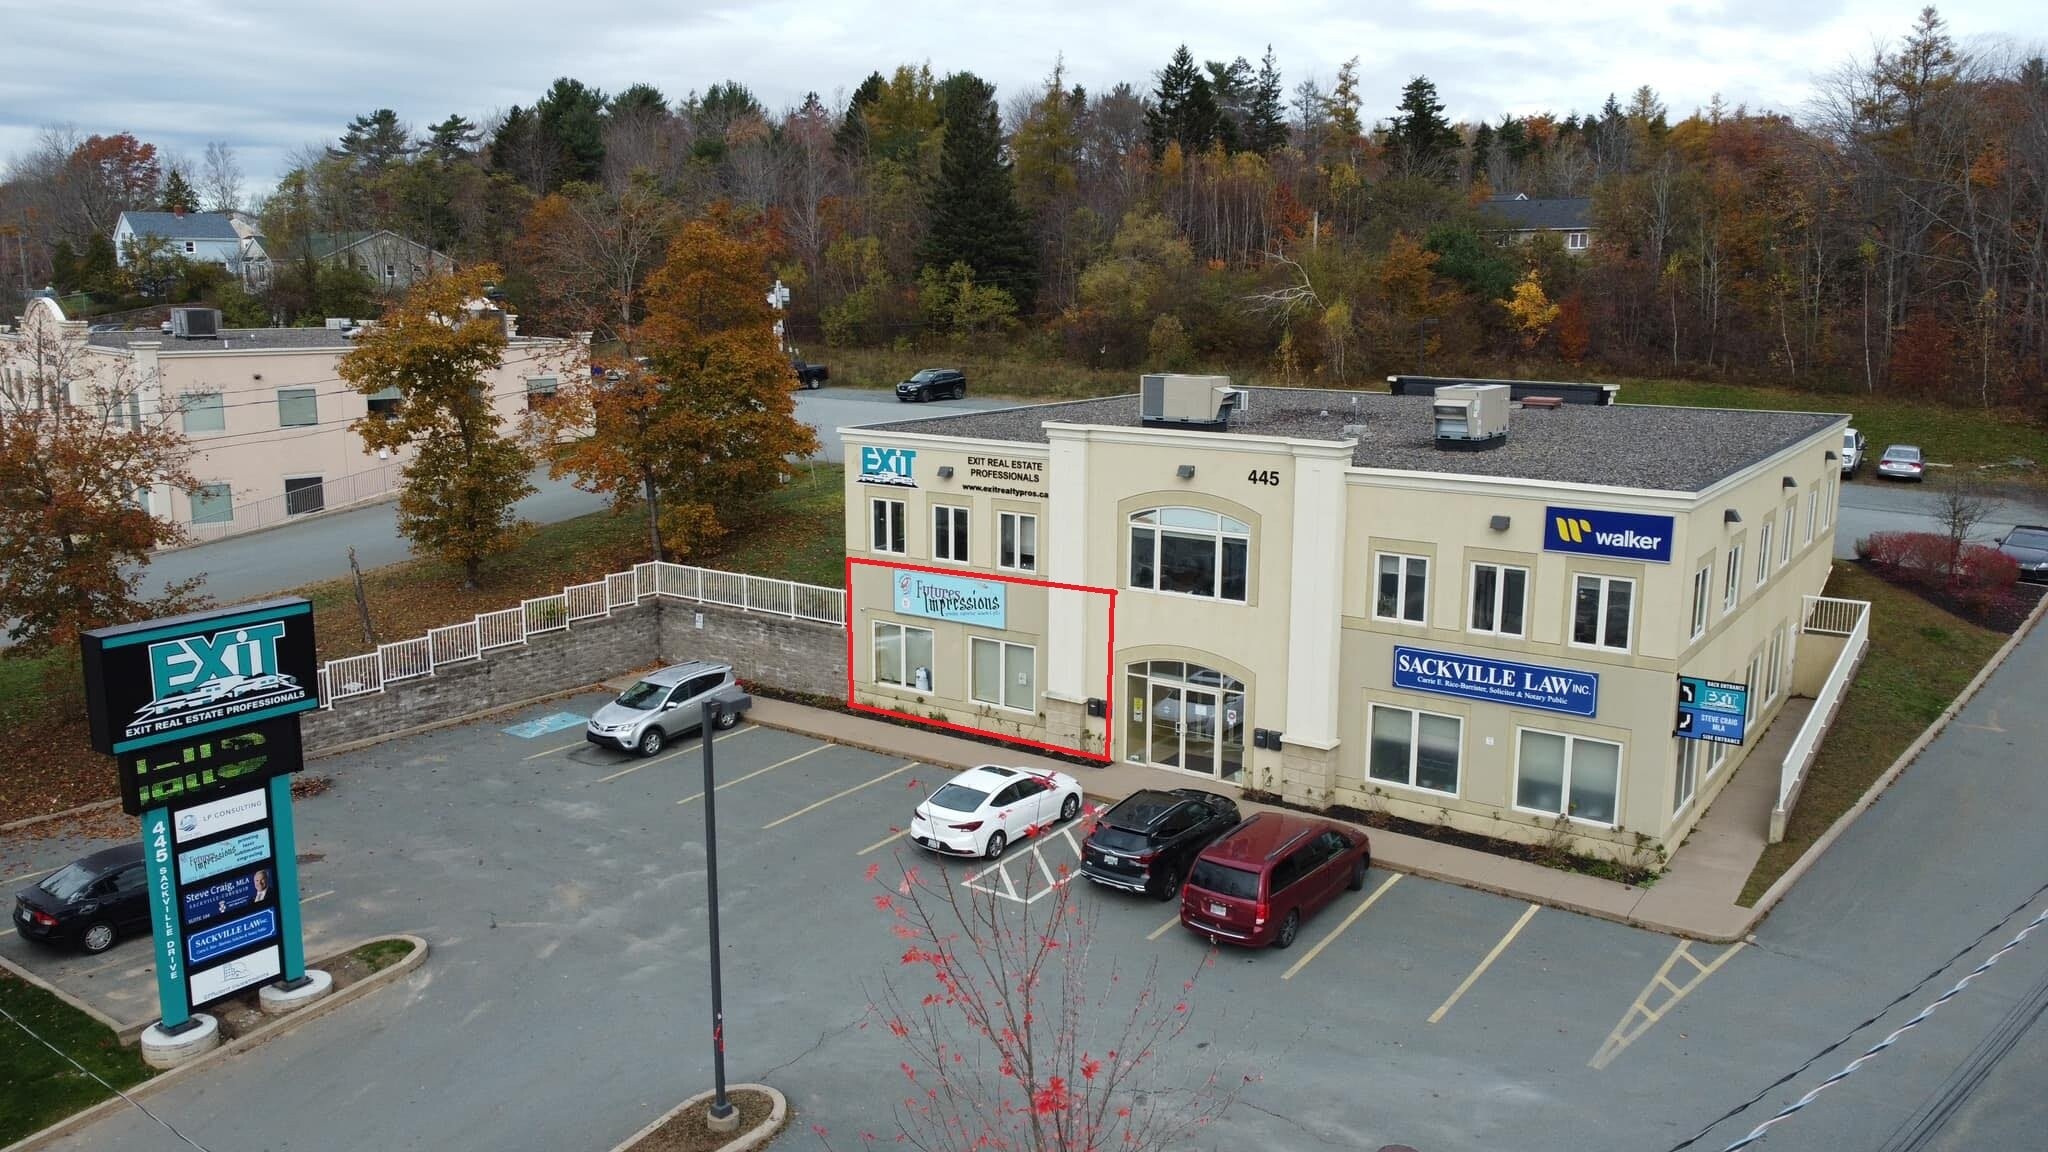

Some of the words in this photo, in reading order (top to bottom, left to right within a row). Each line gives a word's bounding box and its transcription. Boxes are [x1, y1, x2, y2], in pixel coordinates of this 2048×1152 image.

[967, 456, 985, 465] EXIT
[987, 458, 1009, 468] REAL
[1011, 460, 1043, 471] ESTATE
[970, 468, 1040, 483] PROFESSIONALS
[1247, 469, 1280, 486] 445
[962, 484, 1049, 498] www.exitrealtypros.ca
[1595, 530, 1662, 550] walker
[916, 580, 960, 600] Futures
[923, 589, 1000, 616] Impressions
[1398, 654, 1516, 688] SACKVILLE
[1524, 672, 1573, 695] LAW
[1572, 683, 1592, 696] INC.
[1489, 687, 1516, 697] Solicitor
[1524, 691, 1546, 703] Notary
[1546, 694, 1568, 705] Public
[125, 725, 152, 738] EXIT
[155, 719, 183, 732] REAL
[185, 710, 224, 724] ESTATE
[226, 690, 305, 716] PROFESSIONALS
[1701, 714, 1720, 723] STEVE
[1720, 716, 1738, 726] CRAIG
[1712, 723, 1726, 732] MLA
[214, 800, 262, 818] CONSULTING
[186, 889, 209, 903] Steve
[210, 881, 235, 896] Craig,
[236, 877, 250, 887] MLA
[195, 925, 243, 948] SACKVILLE
[243, 919, 261, 931] LAW
